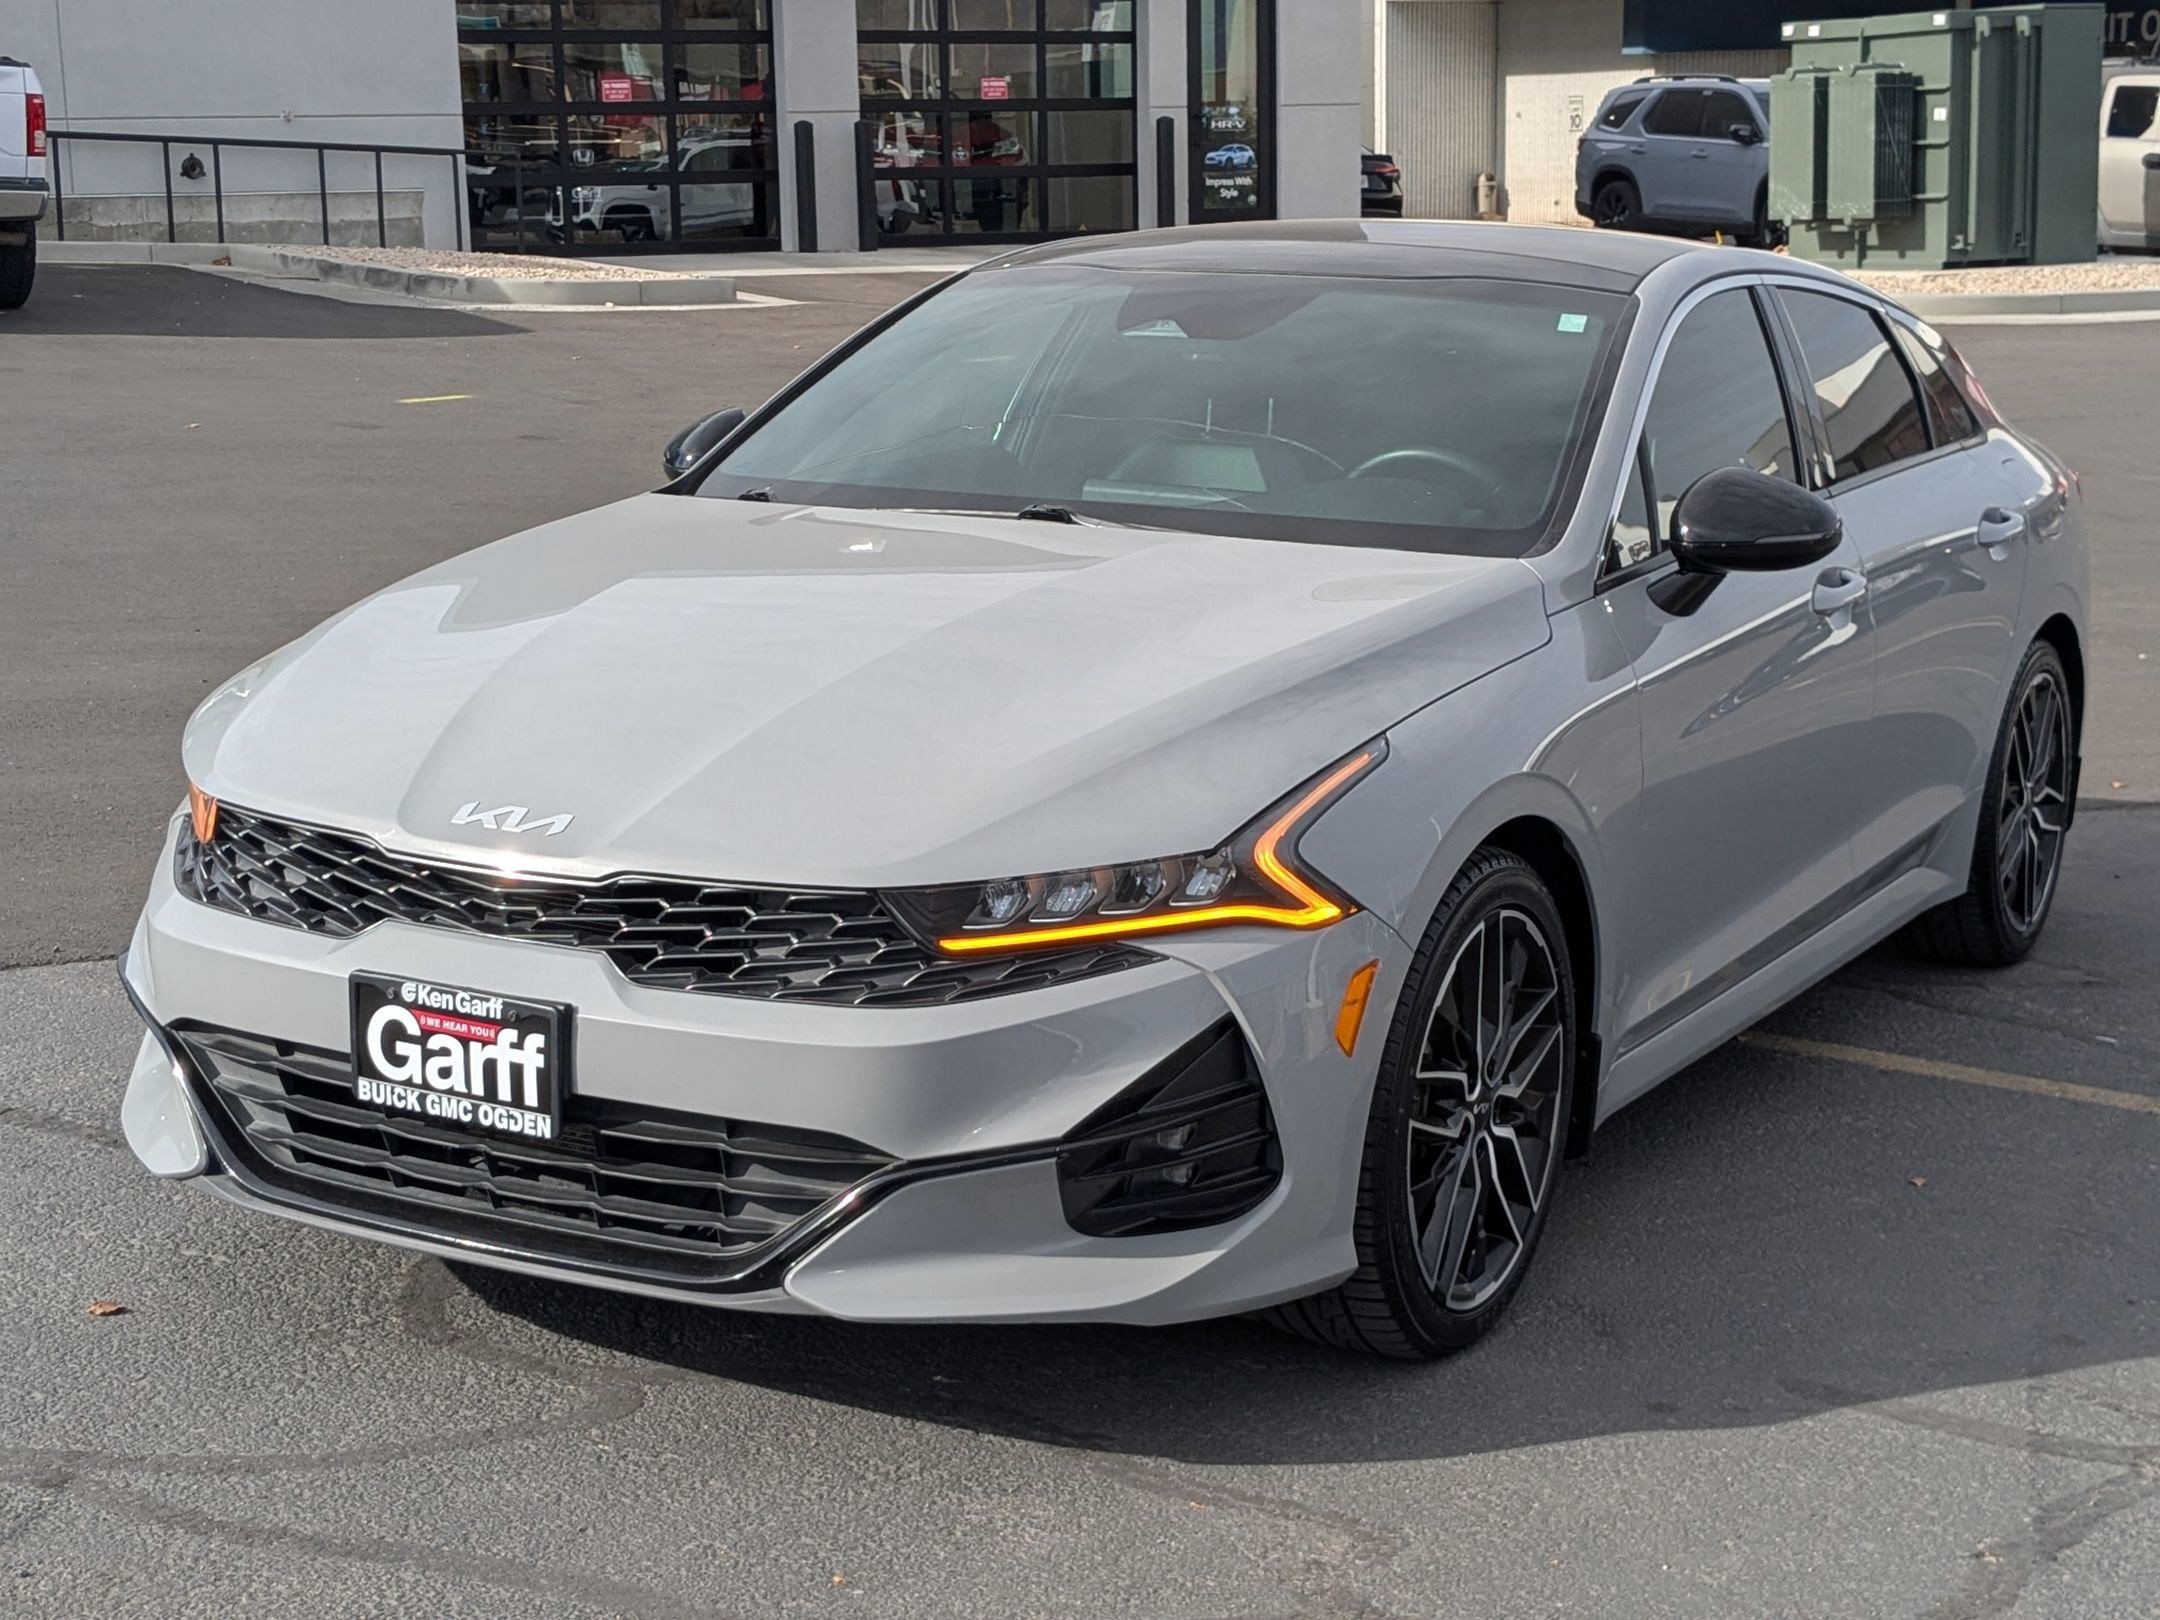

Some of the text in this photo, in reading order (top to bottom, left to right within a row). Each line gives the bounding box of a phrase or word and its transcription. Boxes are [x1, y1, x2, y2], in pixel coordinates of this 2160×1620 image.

[2104, 12, 2134, 42] IT
[1210, 120, 1247, 129] HR-V
[1570, 114, 1582, 128] 10
[1205, 176, 1253, 188] Impress With
[1220, 188, 1239, 199] Style
[450, 801, 575, 837] KIA
[427, 1016, 489, 1038] WE HEAR YOU
[367, 1004, 545, 1108] Garff
[358, 1077, 551, 1139] BUICK GMC OGDEN
